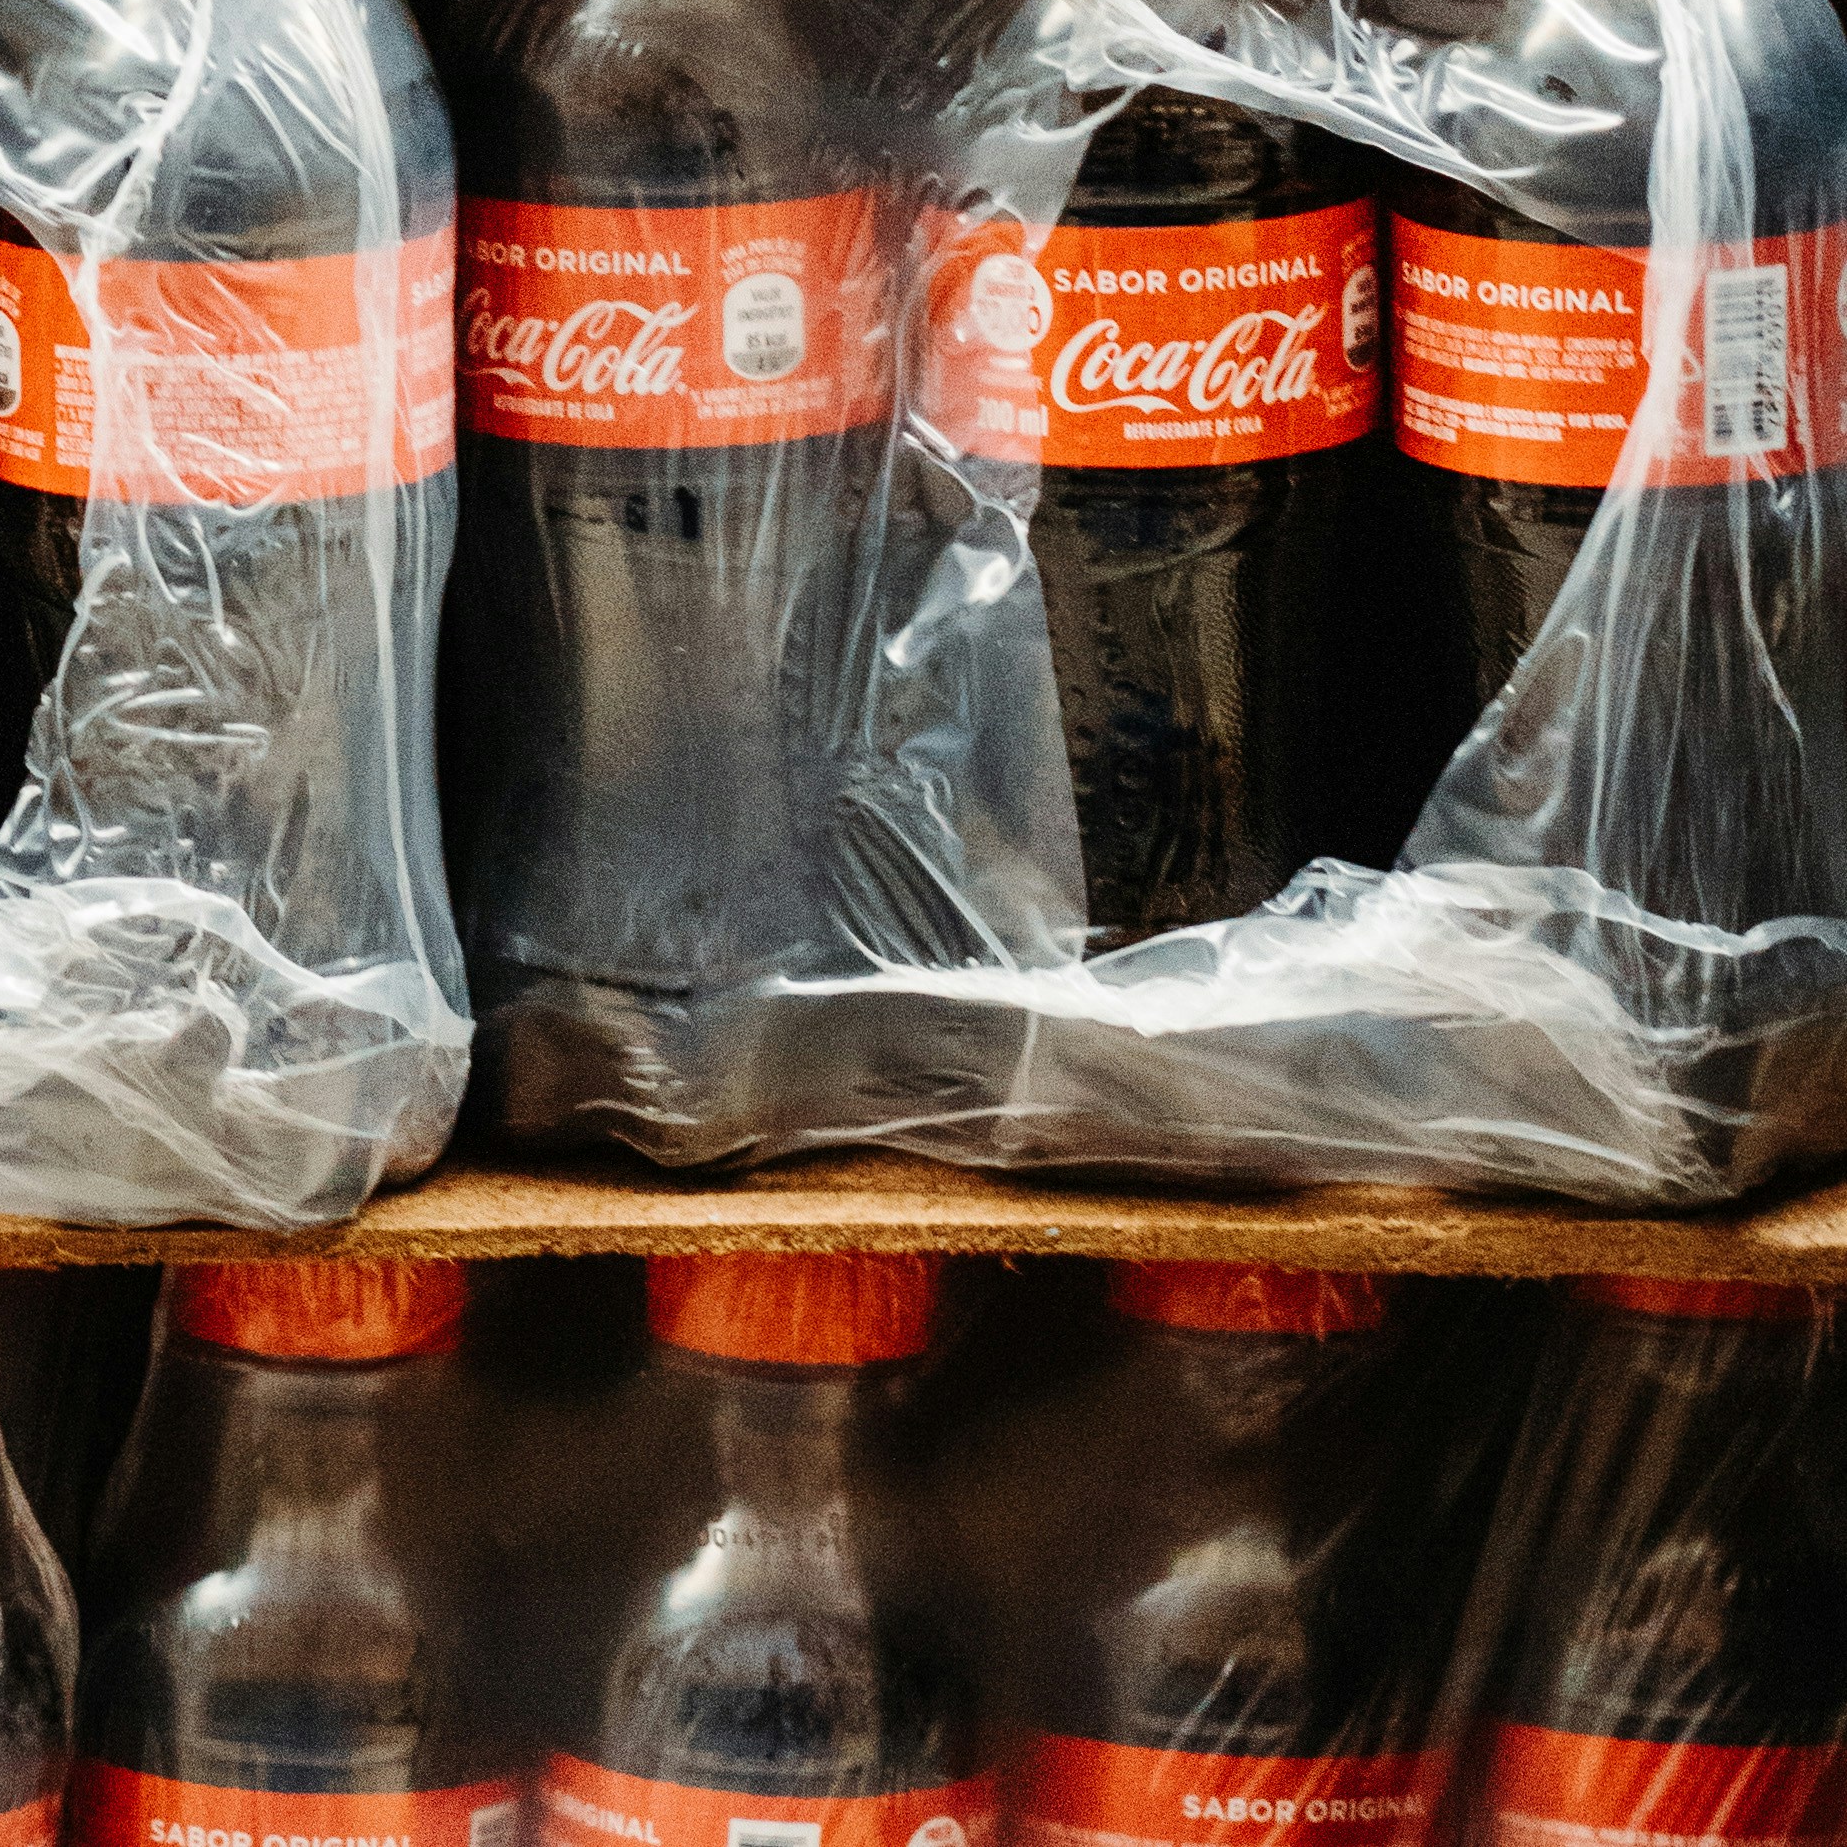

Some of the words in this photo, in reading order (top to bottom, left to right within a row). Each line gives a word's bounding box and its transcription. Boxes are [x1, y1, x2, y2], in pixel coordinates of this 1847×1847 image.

[535, 247, 692, 277] ORIGINAL
[1053, 267, 1170, 295] SABOR
[1178, 254, 1323, 293] ORIGINAL
[1401, 262, 1470, 301] SABOR
[1477, 283, 1634, 315] ORIGINAL
[462, 287, 700, 396] Coca-Cola
[1051, 304, 1328, 414] Coca-Cola
[1182, 1794, 1296, 1823] SABOR
[150, 1818, 253, 1847] SABOR
